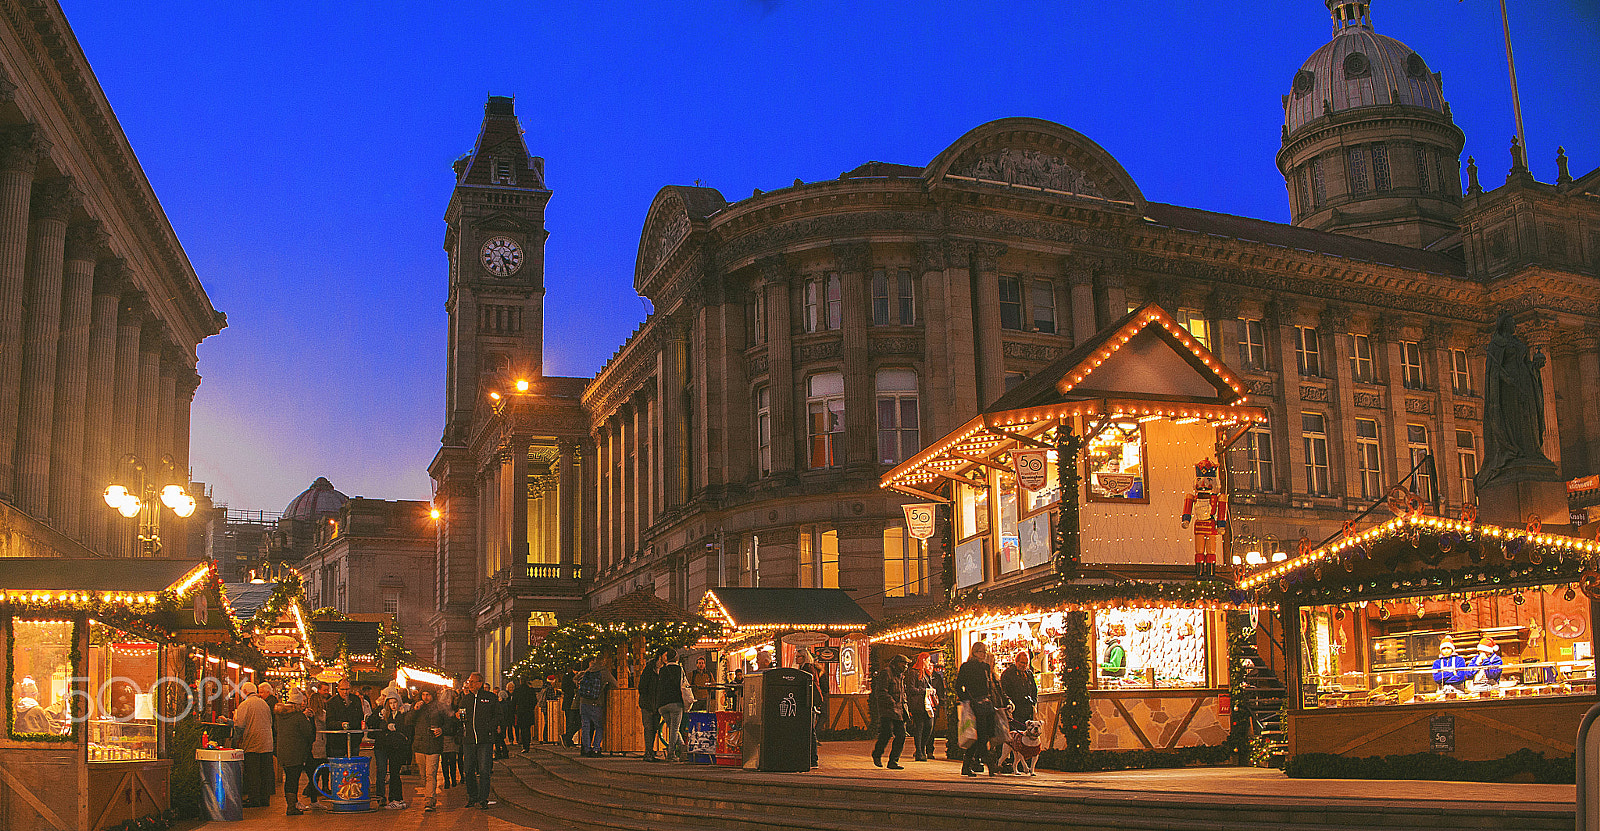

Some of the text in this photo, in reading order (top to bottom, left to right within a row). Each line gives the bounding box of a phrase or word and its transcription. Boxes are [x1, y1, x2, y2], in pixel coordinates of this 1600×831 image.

[1020, 455, 1042, 471] 50
[1103, 477, 1117, 489] 50
[911, 509, 930, 523] 50
[1435, 732, 1447, 743] 50
